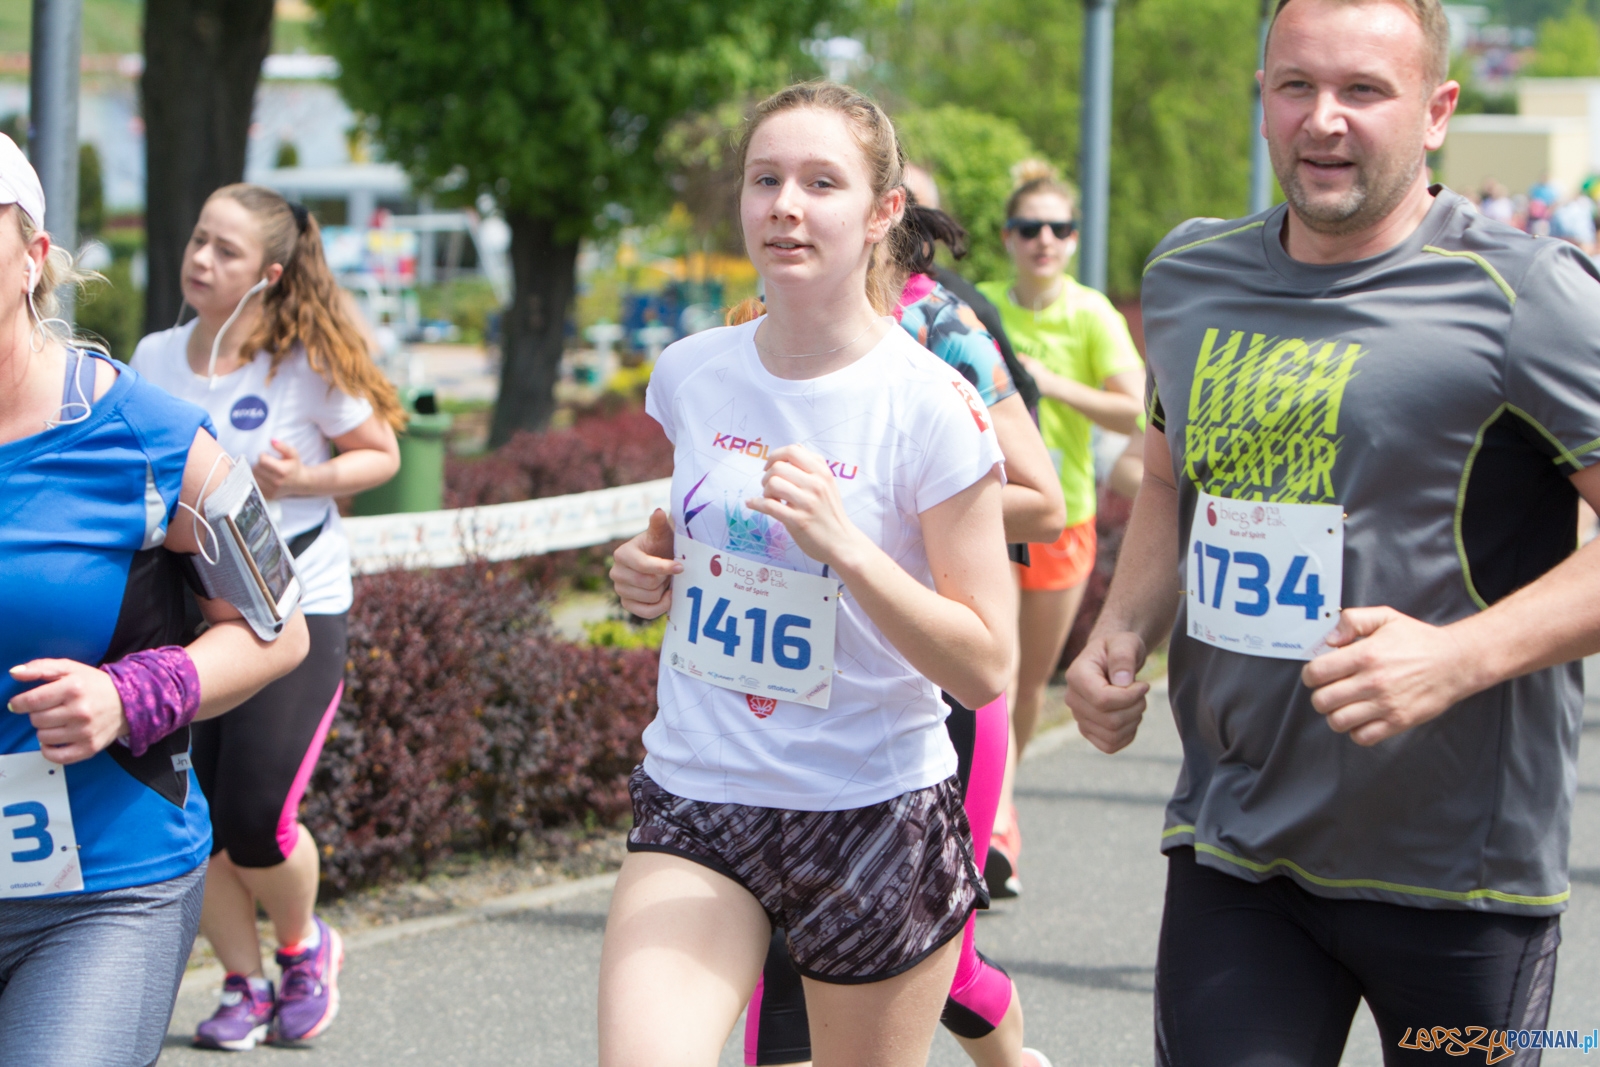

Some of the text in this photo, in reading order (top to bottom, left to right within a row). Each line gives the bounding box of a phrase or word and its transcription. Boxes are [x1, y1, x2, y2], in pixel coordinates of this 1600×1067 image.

[1188, 328, 1362, 435] HIGH
[1185, 425, 1336, 498] PERFOR
[1220, 502, 1250, 529] bieg
[1266, 506, 1280, 515] na
[1229, 529, 1240, 537] Run
[1249, 532, 1266, 540] Spirit
[726, 557, 755, 586] bieg
[770, 568, 783, 578] na
[770, 576, 788, 589] tak
[1194, 540, 1325, 621] 1734
[733, 582, 747, 591] Run
[753, 588, 769, 597] Spirit
[686, 586, 811, 671] 1416
[767, 684, 798, 694] ottobock.
[10, 880, 45, 890] ottobock.
